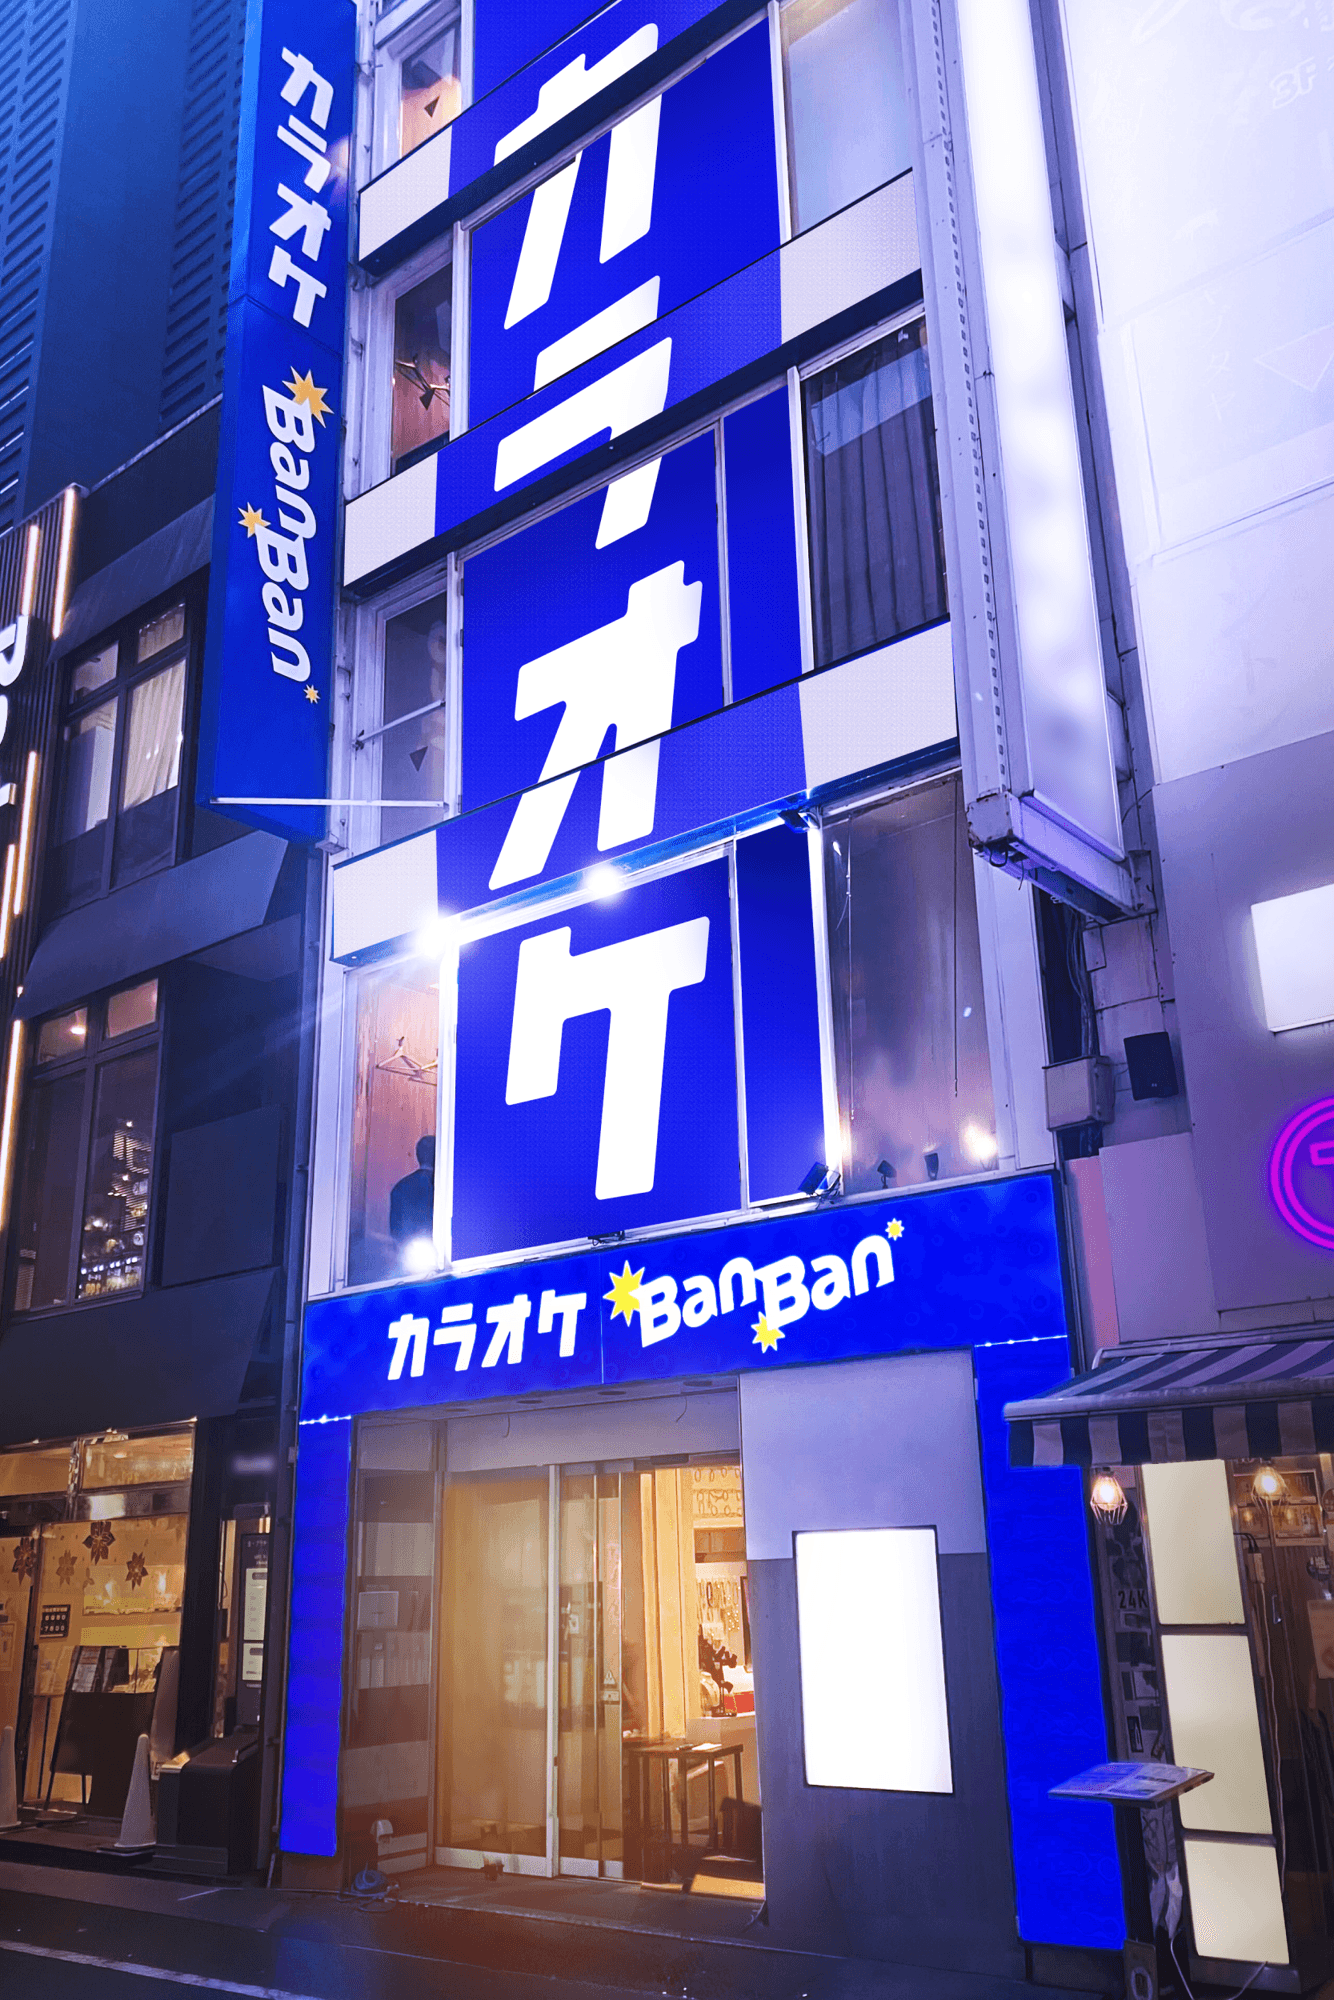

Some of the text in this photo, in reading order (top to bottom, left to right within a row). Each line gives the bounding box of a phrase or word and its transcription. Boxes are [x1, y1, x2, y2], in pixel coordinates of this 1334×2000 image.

[255, 47, 334, 683] カラオケ BanBan
[488, 22, 709, 1202] カラオケ
[387, 1234, 896, 1381] カラオケ BanBan
